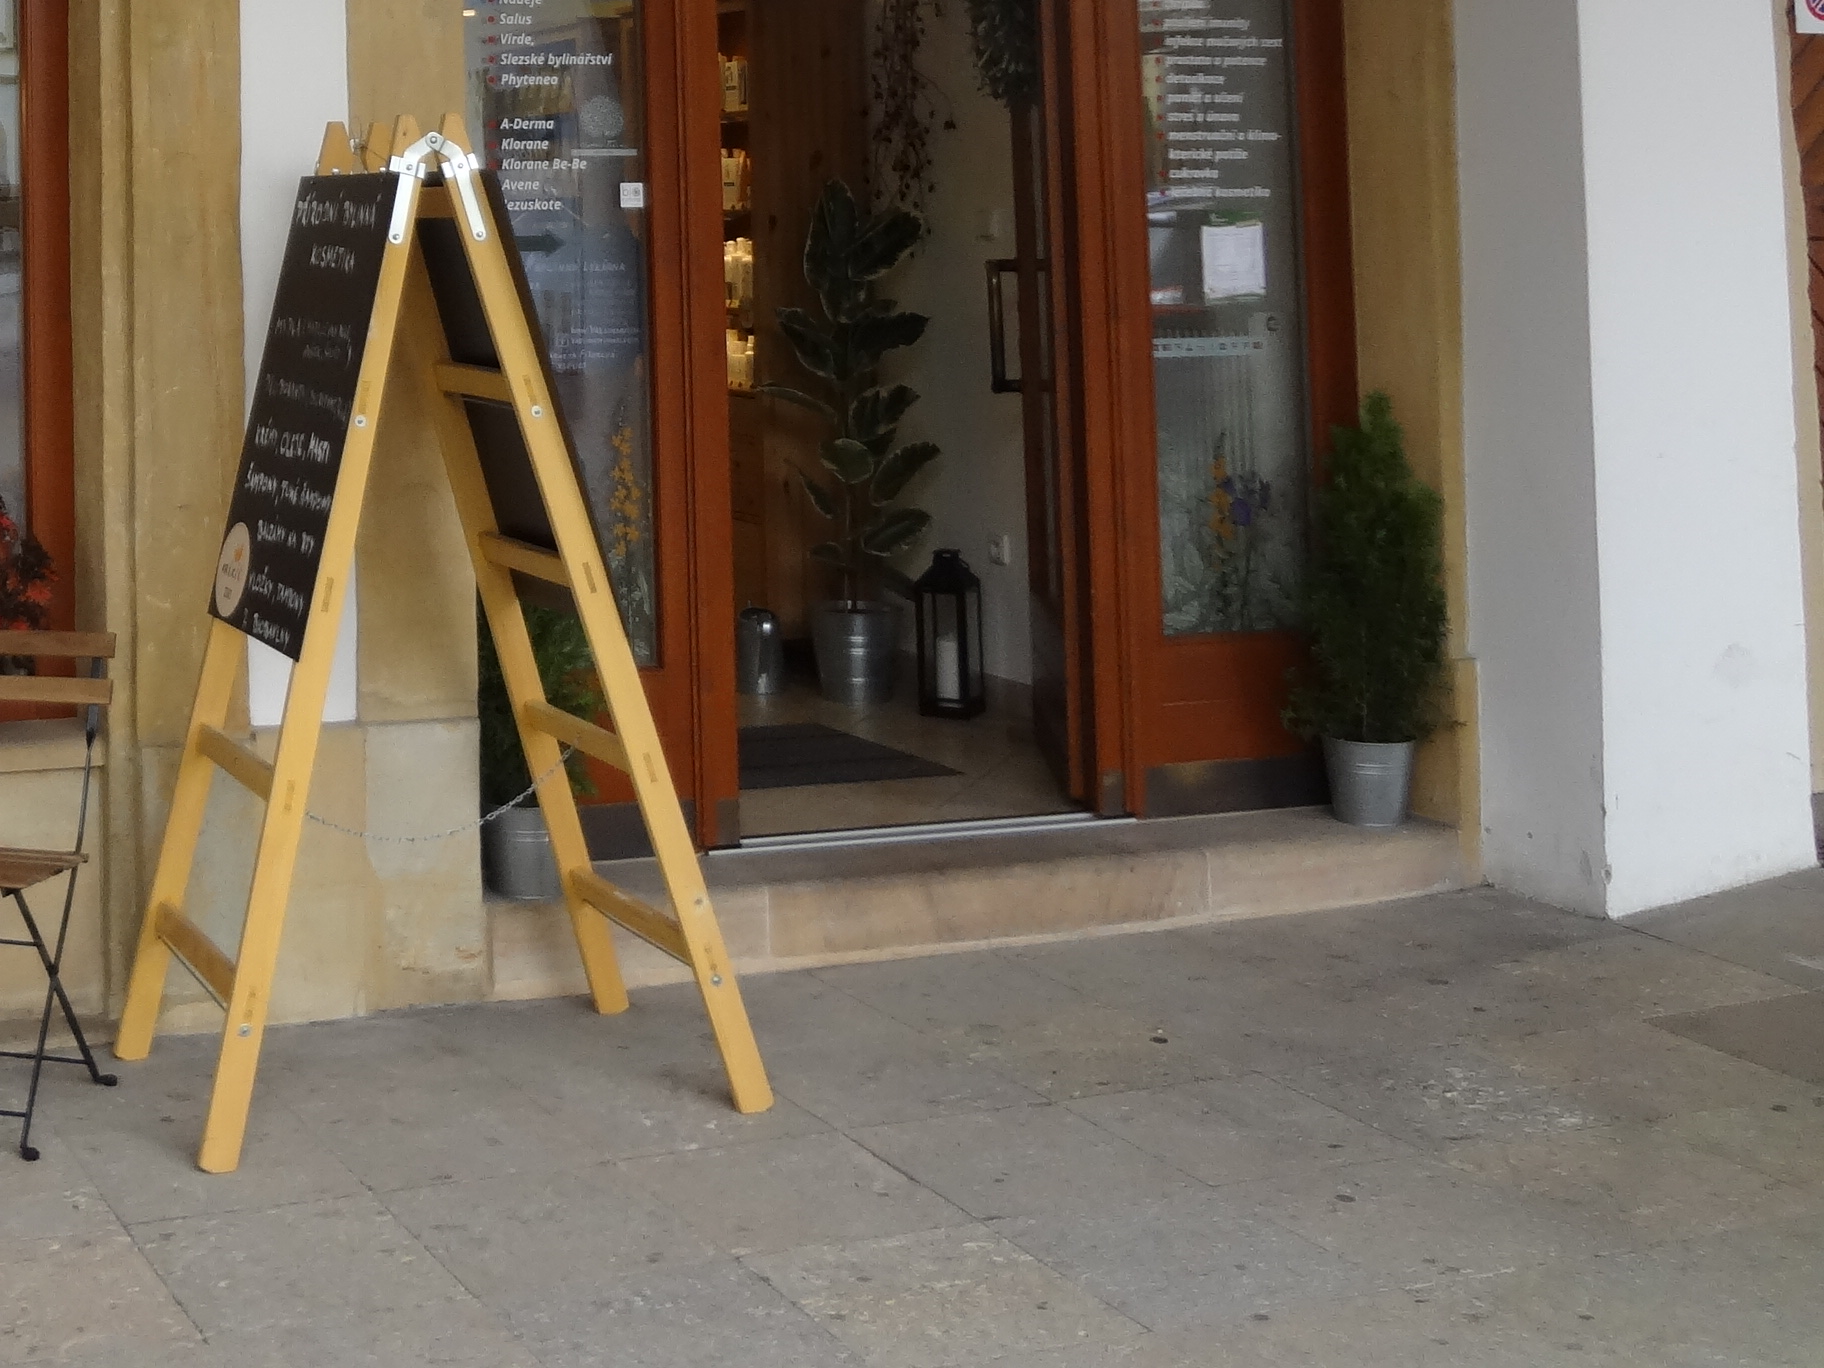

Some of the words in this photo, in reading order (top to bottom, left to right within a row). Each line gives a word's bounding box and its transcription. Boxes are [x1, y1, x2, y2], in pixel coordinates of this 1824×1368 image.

[499, 13, 532, 25] Salus
[500, 53, 545, 65] Slezské
[547, 53, 613, 68] bylinářství
[500, 73, 559, 88] Phyteneo
[500, 118, 555, 130] A-Derma
[501, 137, 549, 150] Klorane
[502, 158, 549, 170] Klorane
[552, 158, 588, 170] Be-Be
[502, 179, 540, 191] Avene
[504, 198, 563, 211] ezuskote
